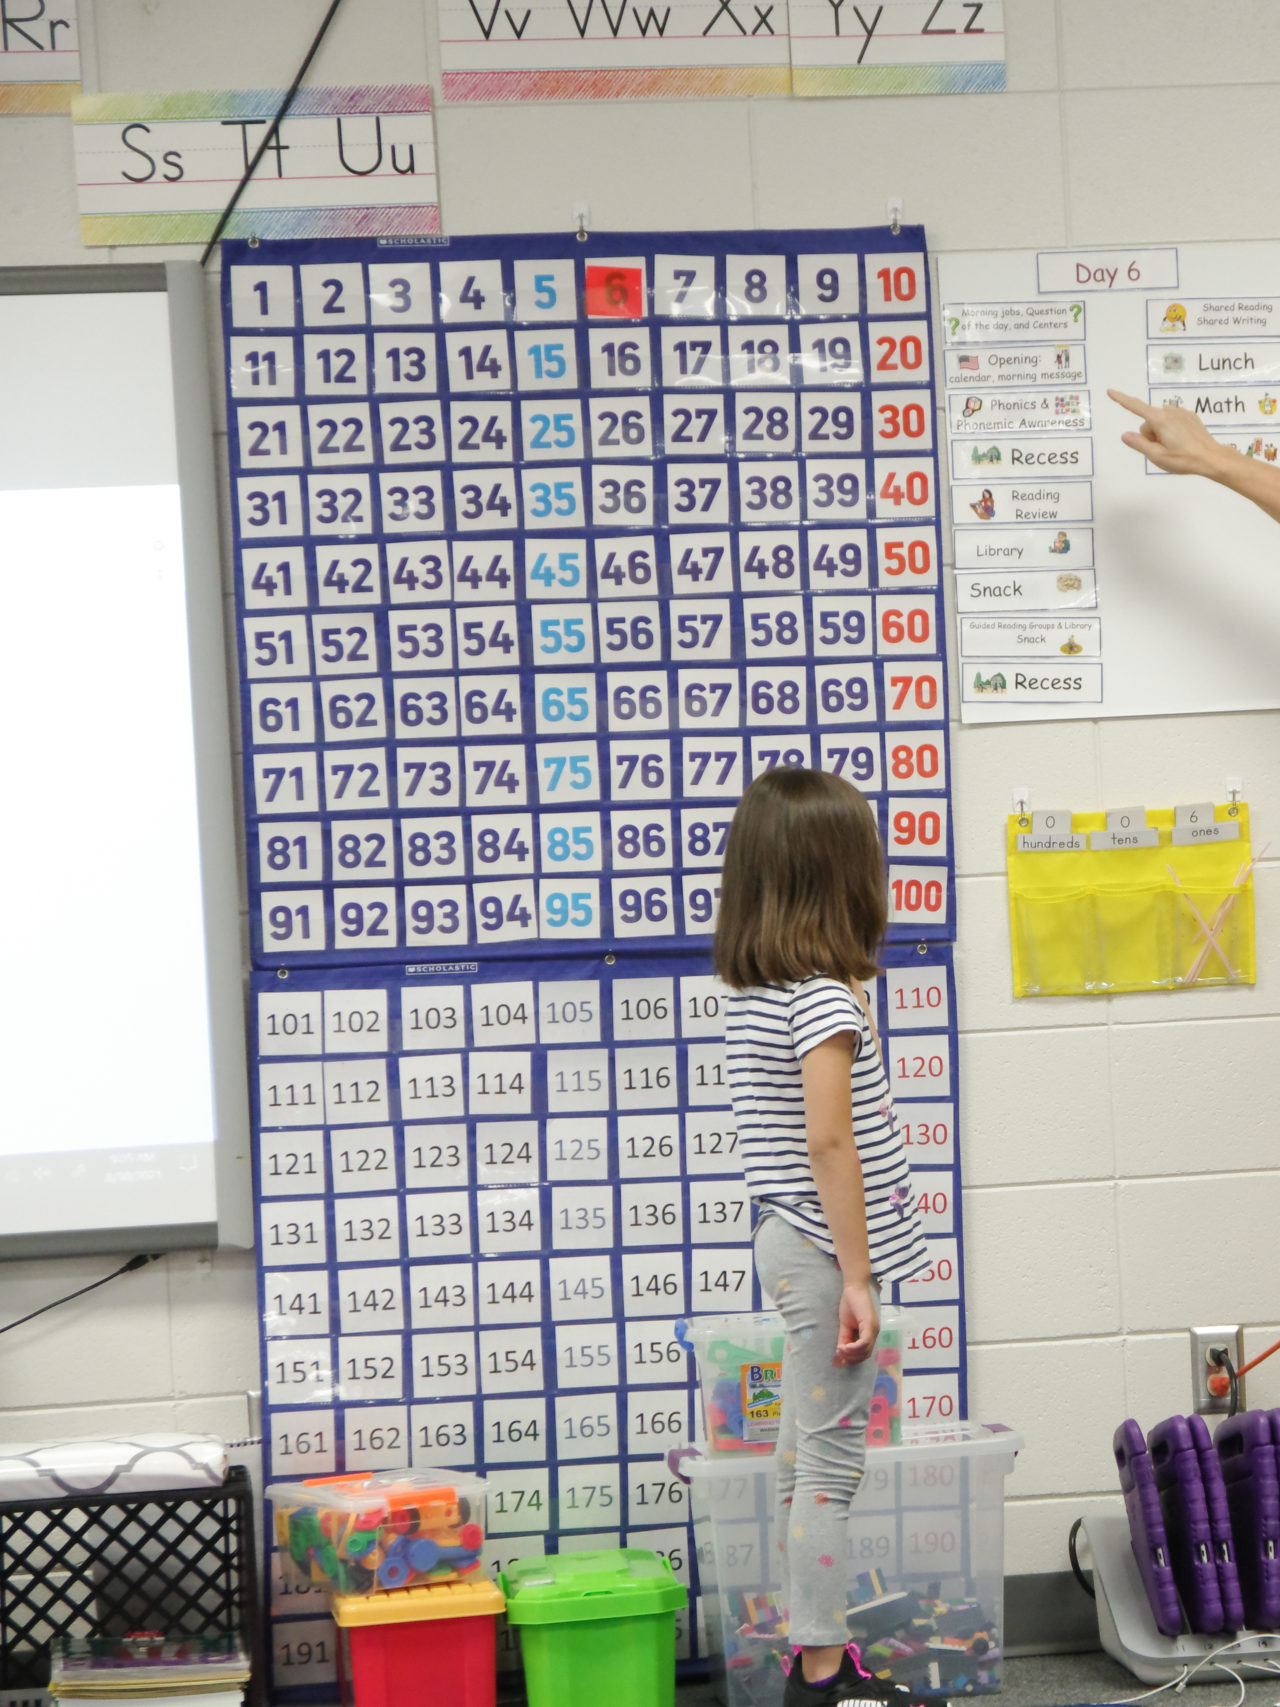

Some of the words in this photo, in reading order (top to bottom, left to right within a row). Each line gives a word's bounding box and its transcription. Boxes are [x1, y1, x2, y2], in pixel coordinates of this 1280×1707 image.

[0, 0, 70, 51] Rr
[468, 0, 532, 40] Vv
[567, 0, 671, 38] Ww
[702, 0, 775, 36] Xx
[828, 0, 883, 64] Yy
[921, 0, 985, 34] Zz
[121, 123, 184, 183] Ss
[221, 118, 290, 179] Tt
[337, 116, 415, 175] Uu
[1075, 262, 1119, 289] Day
[1127, 260, 1141, 282] 6
[253, 281, 268, 315] 1
[322, 279, 345, 314] 2
[389, 278, 411, 313] 3
[459, 276, 485, 310] 4
[534, 275, 556, 309] 5
[604, 271, 629, 307] 6
[674, 270, 696, 303] 7
[744, 269, 767, 303] 8
[816, 268, 839, 302] 9
[877, 267, 916, 302] 10
[1001, 306, 1024, 318] jobs,
[1026, 305, 1067, 315] Question
[1203, 303, 1235, 312] Shared
[1238, 302, 1273, 313] Reading
[961, 322, 971, 331] of
[975, 321, 990, 330] the
[993, 320, 1012, 331] day,
[1013, 321, 1030, 329] and
[1032, 320, 1068, 329] Centers
[1196, 316, 1229, 326] Shared
[1232, 315, 1267, 326] Writing
[988, 354, 1042, 368] Opening:
[1198, 352, 1255, 371] Lunch
[997, 373, 1037, 383] morning
[1040, 370, 1083, 382] message
[990, 398, 1037, 411] Phonics
[1040, 398, 1050, 409] &
[1194, 395, 1246, 413] Math
[248, 421, 287, 456] 21
[316, 417, 365, 454] 22
[388, 415, 436, 452] 23
[458, 415, 507, 450] 24
[530, 414, 575, 448] 25
[598, 410, 645, 446] 26
[671, 408, 718, 442] 27
[743, 406, 789, 441] 28
[808, 406, 854, 440] 29
[878, 403, 925, 439] 30
[956, 419, 1015, 431] Phonemic
[1019, 417, 1085, 429] Awareness
[1011, 448, 1080, 466] Recess
[1011, 488, 1060, 503] Reading
[1015, 508, 1058, 520] Review
[976, 545, 1024, 559] Library
[251, 561, 292, 596] 41
[323, 558, 373, 594] 42
[393, 555, 443, 591] 43
[458, 555, 510, 589] 44
[530, 553, 580, 587] 45
[601, 550, 651, 586] 46
[677, 546, 724, 582] 47
[744, 544, 795, 579] 48
[813, 543, 862, 578] 49
[884, 540, 930, 576] 50
[970, 580, 1023, 598] Snack
[969, 622, 996, 630] Guided
[998, 621, 1027, 631] Reading
[1029, 621, 1055, 631] Groups
[1064, 621, 1092, 630] Library
[1017, 634, 1046, 644] Snack
[1015, 672, 1082, 690] Recess
[259, 697, 299, 732] 61
[329, 692, 377, 729] 62
[400, 691, 448, 727] 63
[465, 689, 517, 724] 64
[542, 687, 589, 722] 65
[613, 685, 662, 720] 66
[685, 683, 732, 717] 67
[751, 680, 800, 715] 68
[821, 677, 868, 713] 69
[890, 675, 937, 710] 70
[1189, 811, 1199, 823] 6
[267, 836, 307, 870] 81
[338, 833, 386, 868] 82
[408, 831, 456, 866] 83
[477, 828, 529, 863] 84
[548, 826, 594, 861] 85
[618, 823, 666, 859] 86
[687, 821, 732, 856] 87
[894, 811, 940, 845] 90
[1111, 832, 1139, 845] tens
[1191, 827, 1220, 838] ones
[1022, 835, 1081, 849] hundreds
[416, 964, 475, 972] SCHOLASTIC
[267, 1013, 314, 1035] 101
[333, 1011, 380, 1033] 102
[410, 1007, 457, 1030] 103
[481, 1003, 528, 1027] 104
[547, 1001, 592, 1023] 105
[621, 998, 667, 1020] 106
[688, 995, 728, 1019] 10
[895, 986, 941, 1009] 110
[269, 1152, 317, 1176] 121
[340, 1148, 388, 1173] 122
[413, 1145, 460, 1168] 123
[485, 1142, 532, 1165] 124
[555, 1139, 600, 1160] 125
[627, 1136, 673, 1158] 126
[692, 1132, 739, 1154] 127
[902, 1123, 948, 1145] 130
[273, 1293, 323, 1315] 141
[348, 1289, 396, 1313] 142
[419, 1285, 466, 1308] 143
[487, 1281, 534, 1304] 144
[559, 1278, 604, 1300] 145
[631, 1274, 677, 1297] 146
[700, 1271, 745, 1292] 147
[750, 1410, 769, 1418] 163
[280, 1432, 327, 1455] 161
[353, 1428, 401, 1451] 162
[419, 1424, 467, 1448] 163
[492, 1420, 539, 1443] 164
[565, 1415, 610, 1439] 165
[634, 1411, 682, 1435] 166
[907, 1395, 953, 1418] 170
[494, 1490, 542, 1513] 174
[568, 1486, 612, 1508] 175
[635, 1481, 683, 1505] 176
[909, 1465, 954, 1487] 180
[909, 1531, 956, 1554] 190
[280, 1641, 330, 1666] 191
